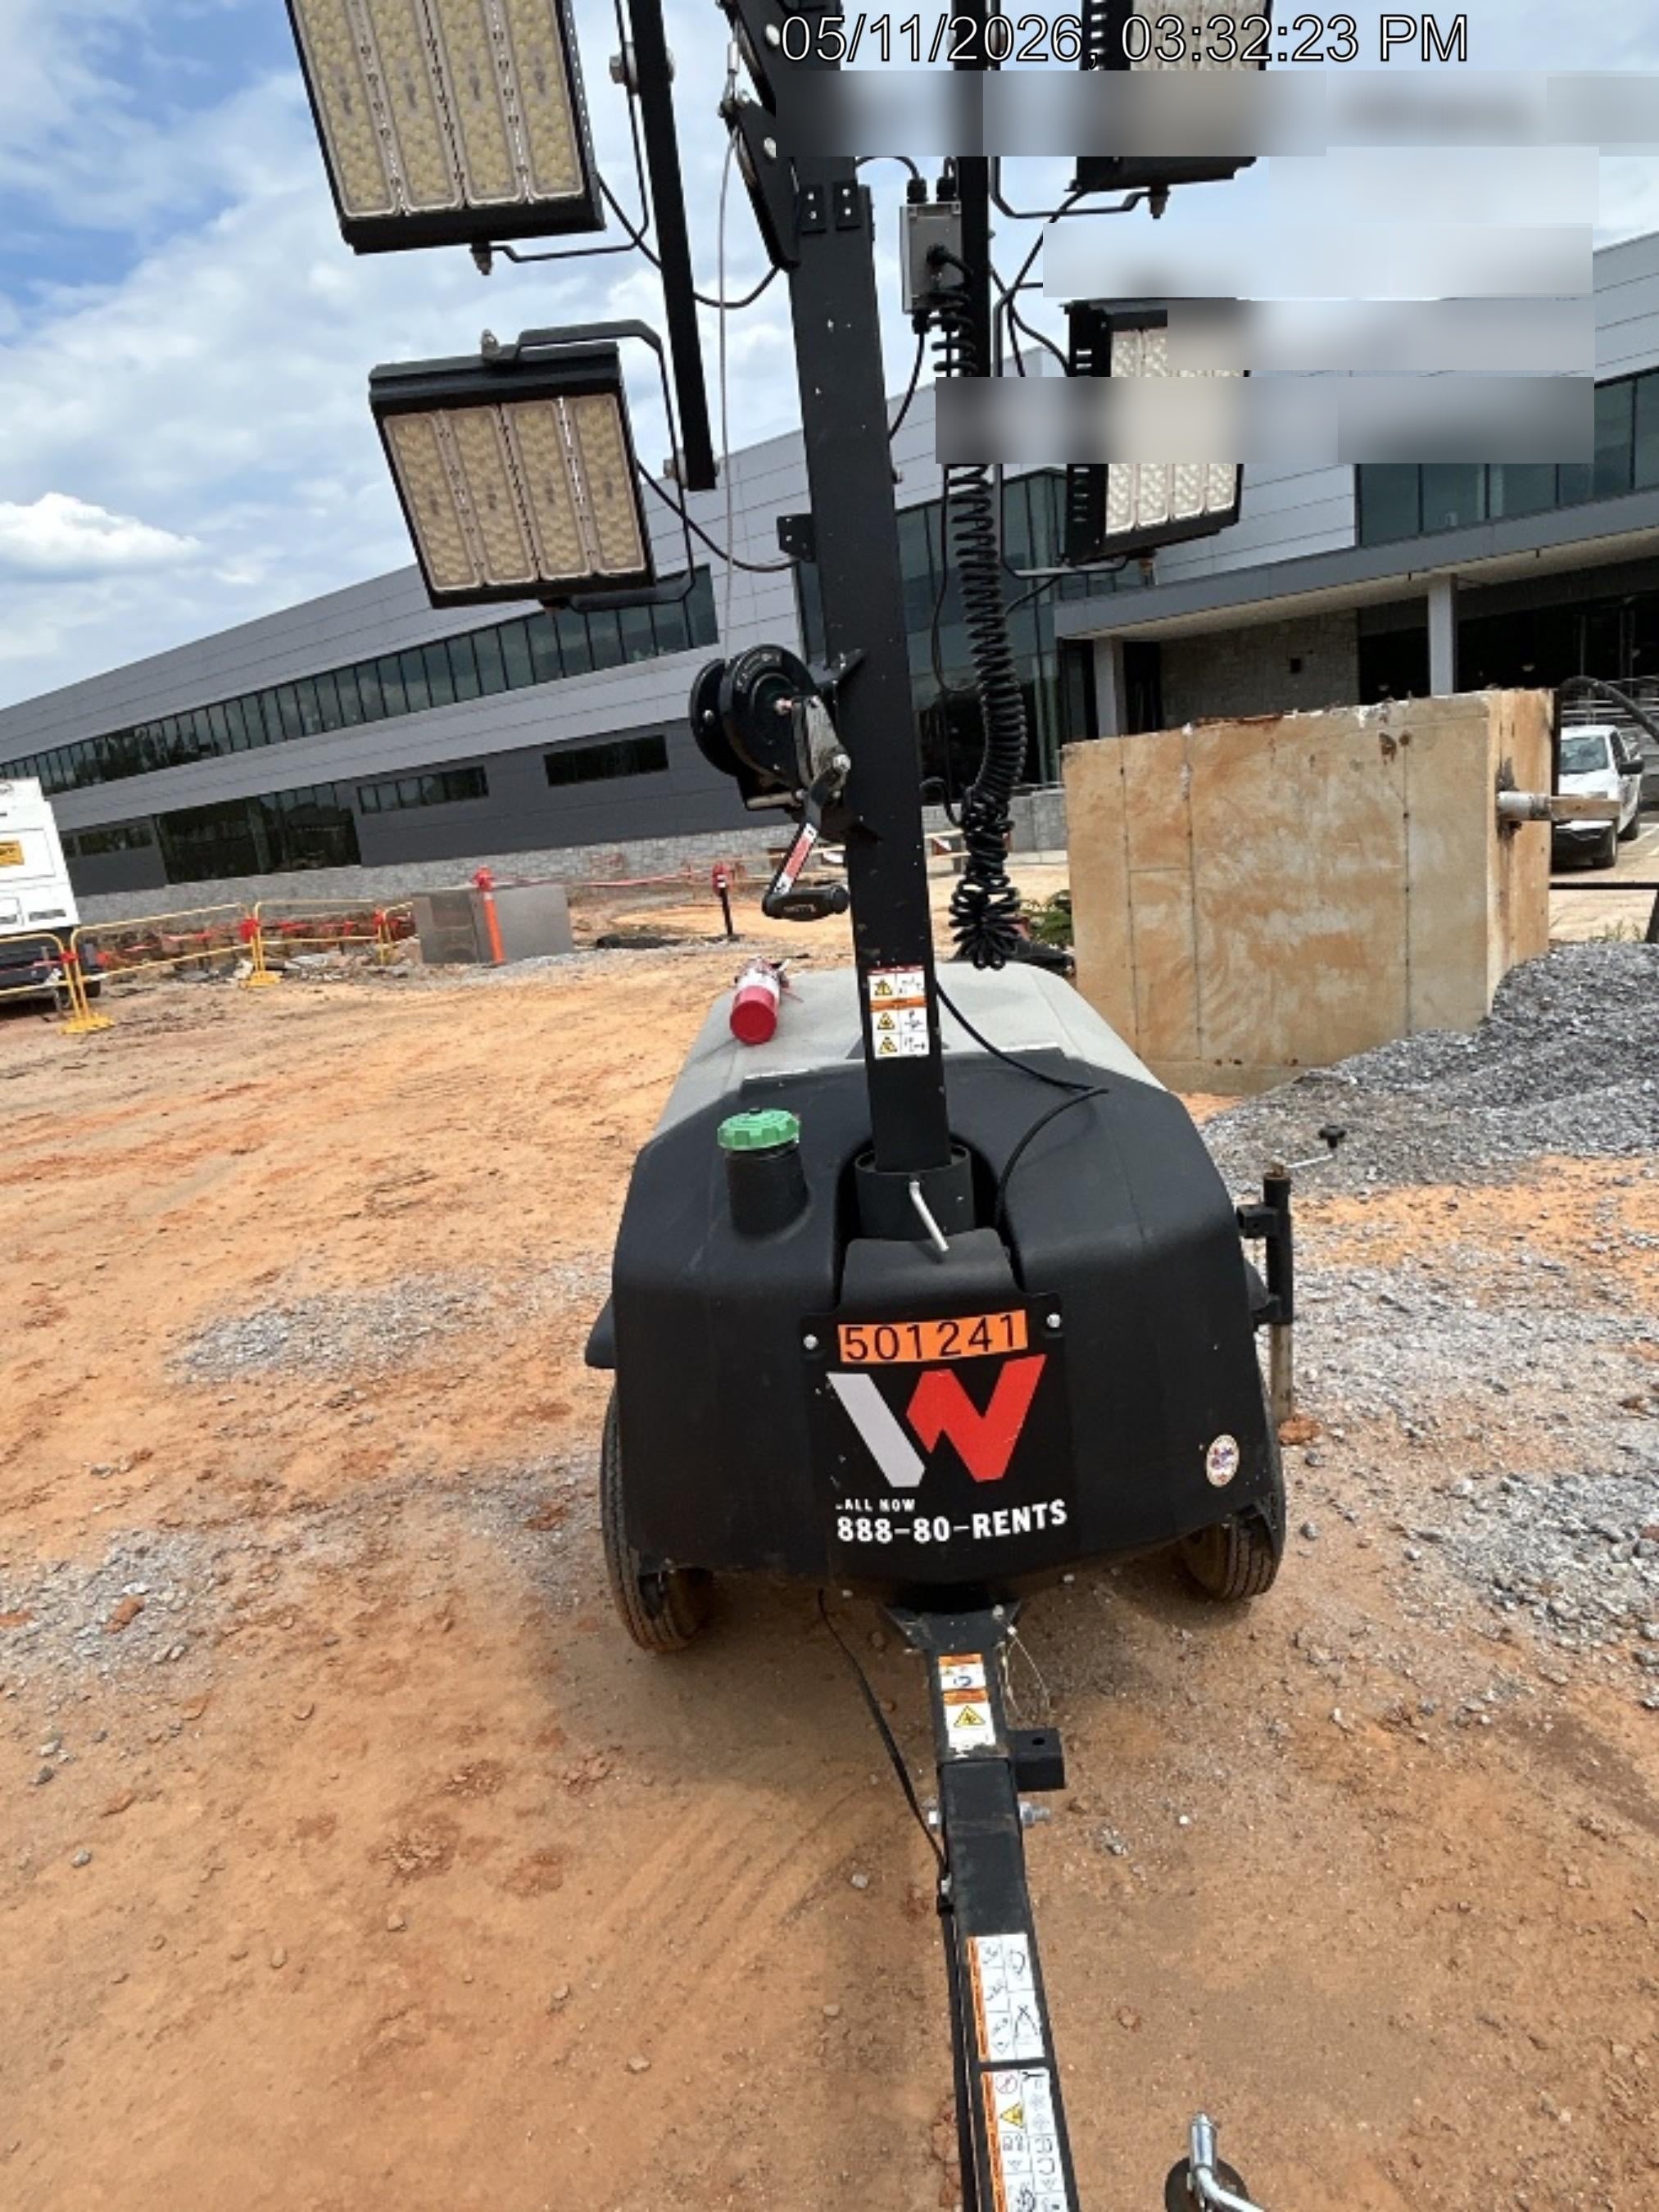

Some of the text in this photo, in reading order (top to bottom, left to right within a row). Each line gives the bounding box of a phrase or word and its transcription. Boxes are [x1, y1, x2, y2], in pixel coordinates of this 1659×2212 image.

[844, 1314, 1015, 1360] 501241
[837, 1498, 1067, 1543] 888-80-RENTS
[879, 1498, 916, 1512] NOW
